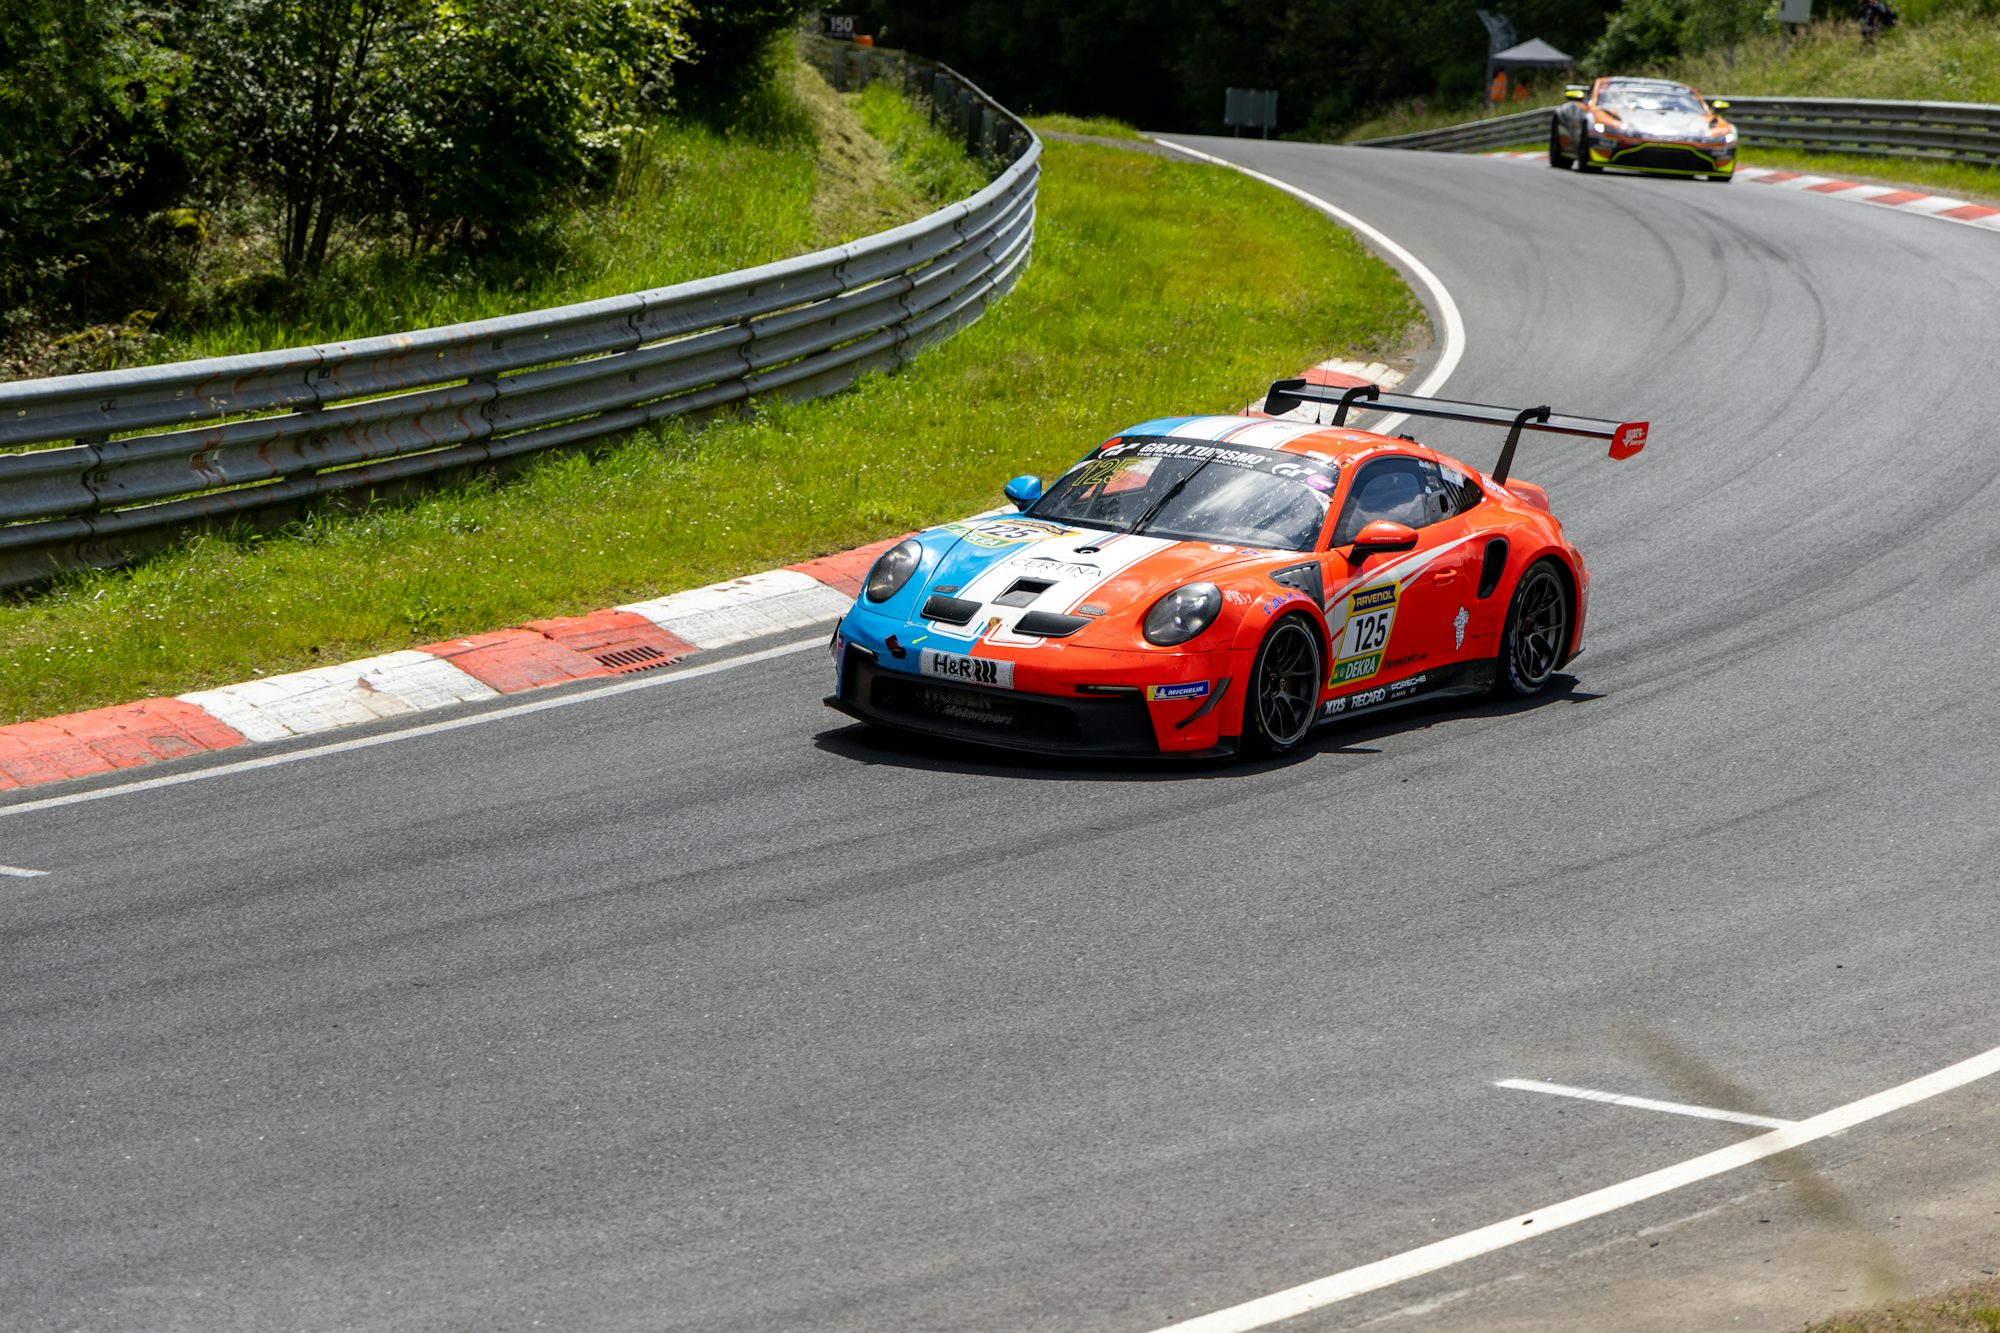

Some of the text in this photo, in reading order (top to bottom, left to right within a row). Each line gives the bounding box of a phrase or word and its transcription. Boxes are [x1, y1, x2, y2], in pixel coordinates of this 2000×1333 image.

[831, 16, 854, 32] 150
[1139, 443, 1191, 454] GRAN
[1071, 457, 1141, 487] 125
[1209, 458, 1254, 469] IMULATOR
[978, 524, 1039, 539] 125
[1010, 558, 1102, 578] CERTINA
[1356, 590, 1393, 607] RAVENOL
[1354, 612, 1388, 653] 125
[933, 652, 972, 678] H&R
[1345, 656, 1376, 680] DEKRA
[1168, 686, 1204, 696] MICHELIN
[1351, 688, 1386, 709] RECARO
[1391, 675, 1427, 691] PORSCHE
